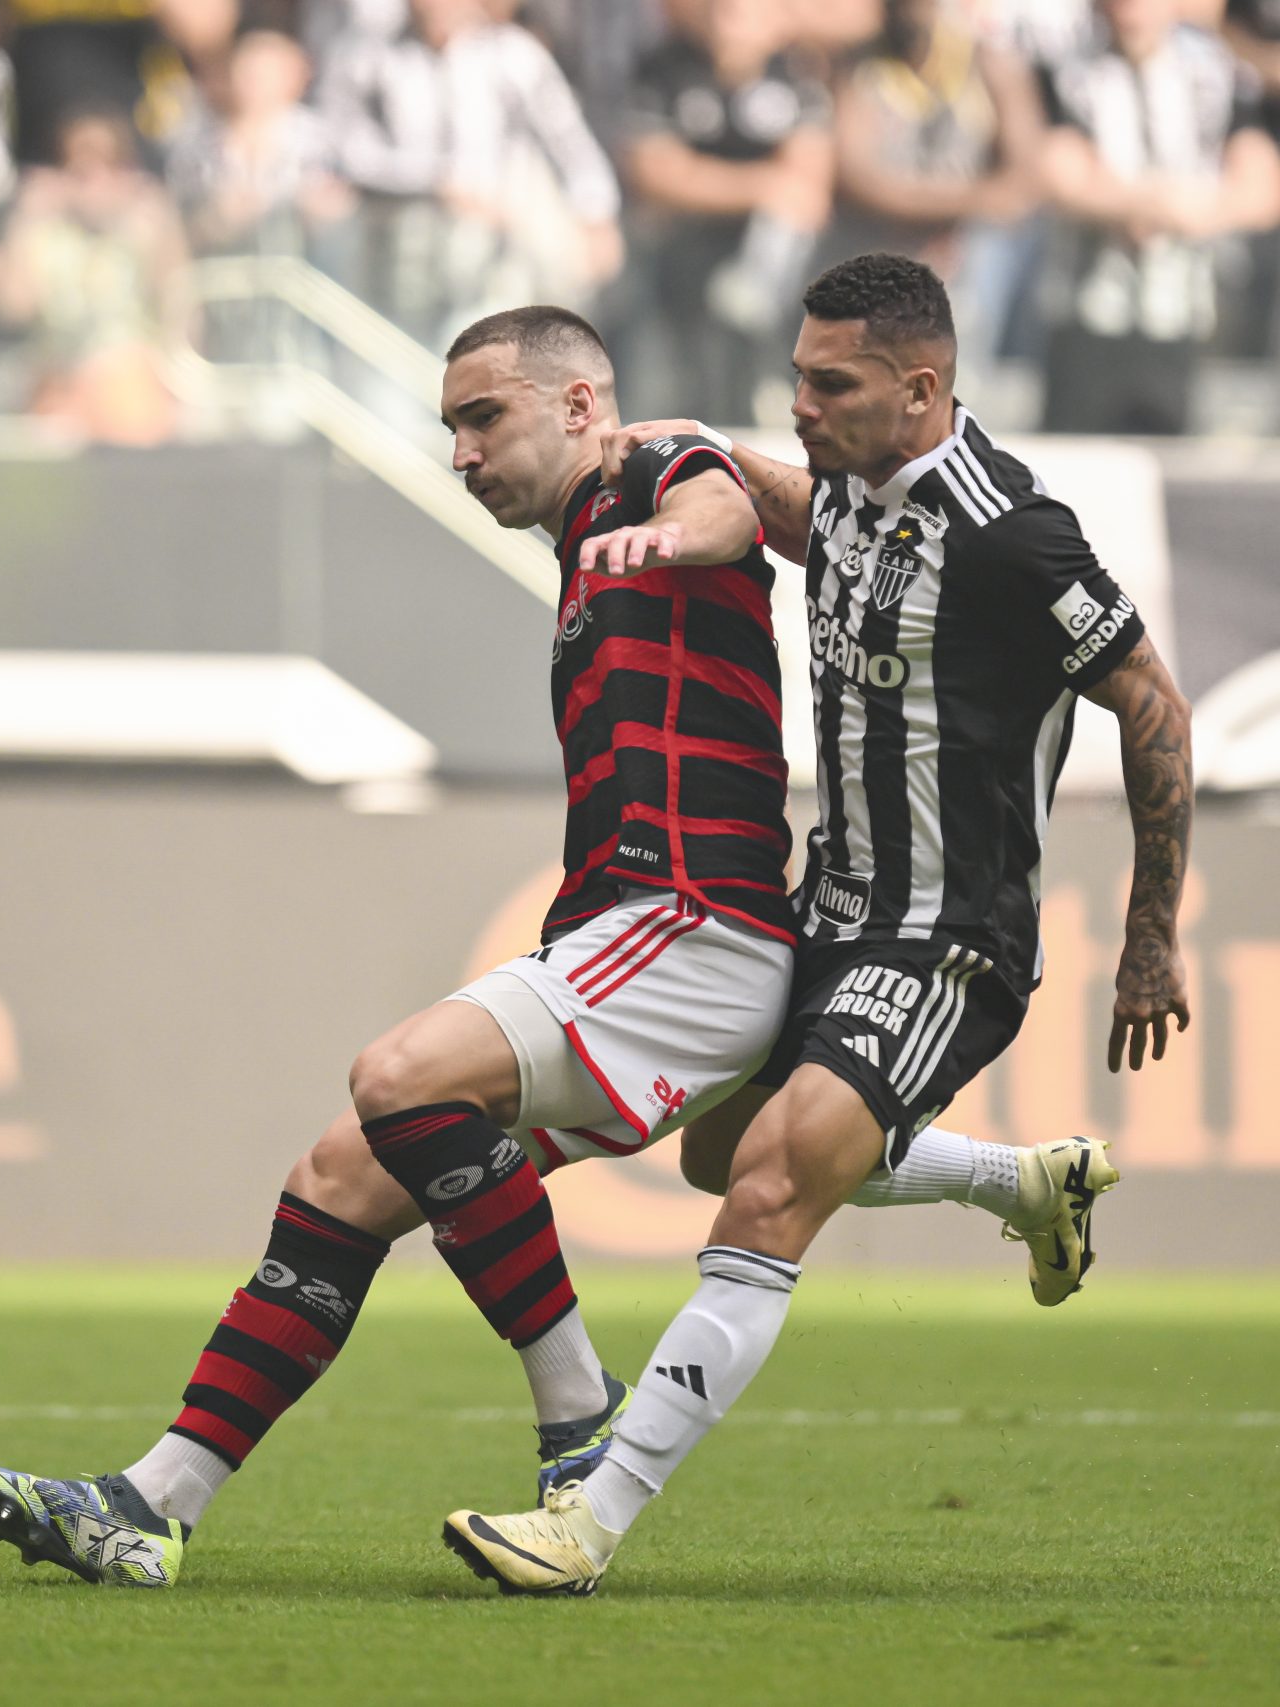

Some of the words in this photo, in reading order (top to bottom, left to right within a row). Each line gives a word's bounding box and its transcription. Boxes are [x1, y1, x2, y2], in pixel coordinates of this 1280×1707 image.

[881, 552, 916, 572] CAM
[1062, 593, 1136, 674] GERDAU
[618, 844, 659, 863] HEAT.RDY
[834, 965, 922, 1010] AUTO
[823, 992, 909, 1037] TRUCK
